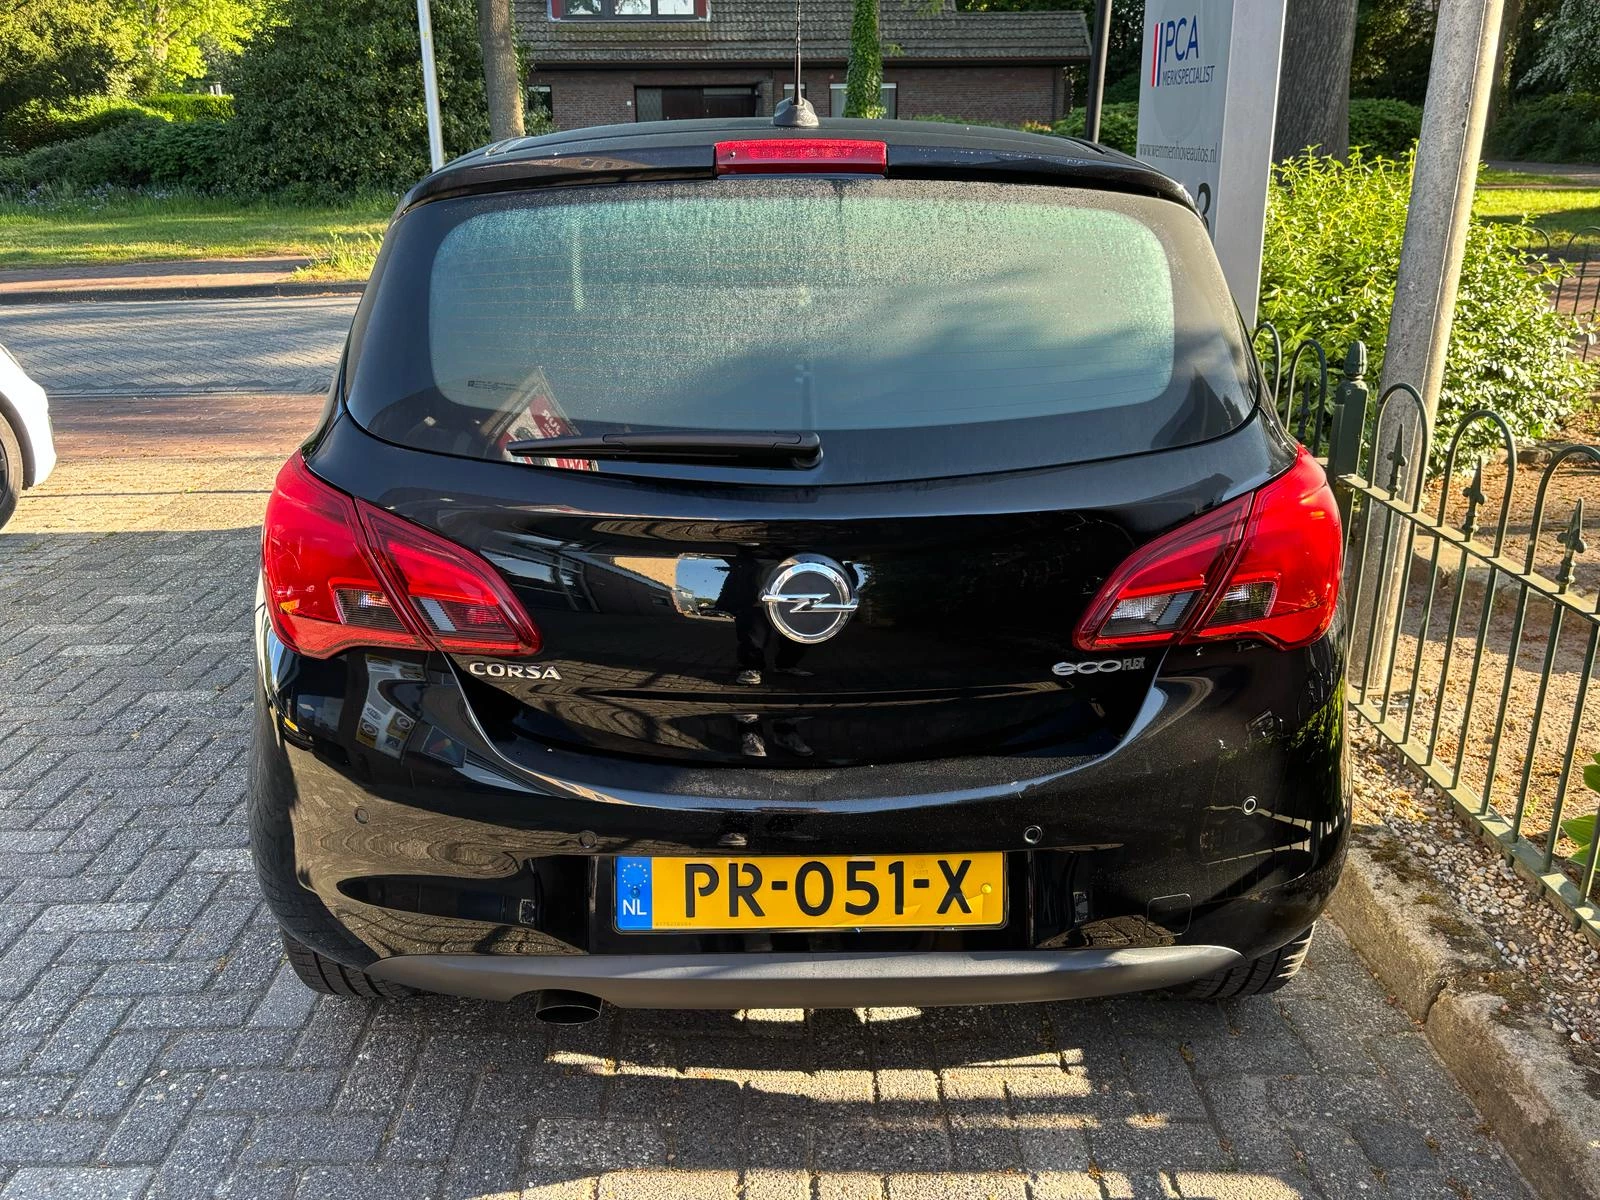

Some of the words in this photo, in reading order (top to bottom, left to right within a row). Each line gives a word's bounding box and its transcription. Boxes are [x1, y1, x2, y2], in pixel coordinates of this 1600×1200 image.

[1163, 15, 1199, 63] PCA
[1162, 65, 1216, 87] MERKSPECIALIST
[469, 662, 562, 680] CORSA
[684, 859, 972, 918] PR-051-X
[622, 899, 647, 916] NL
